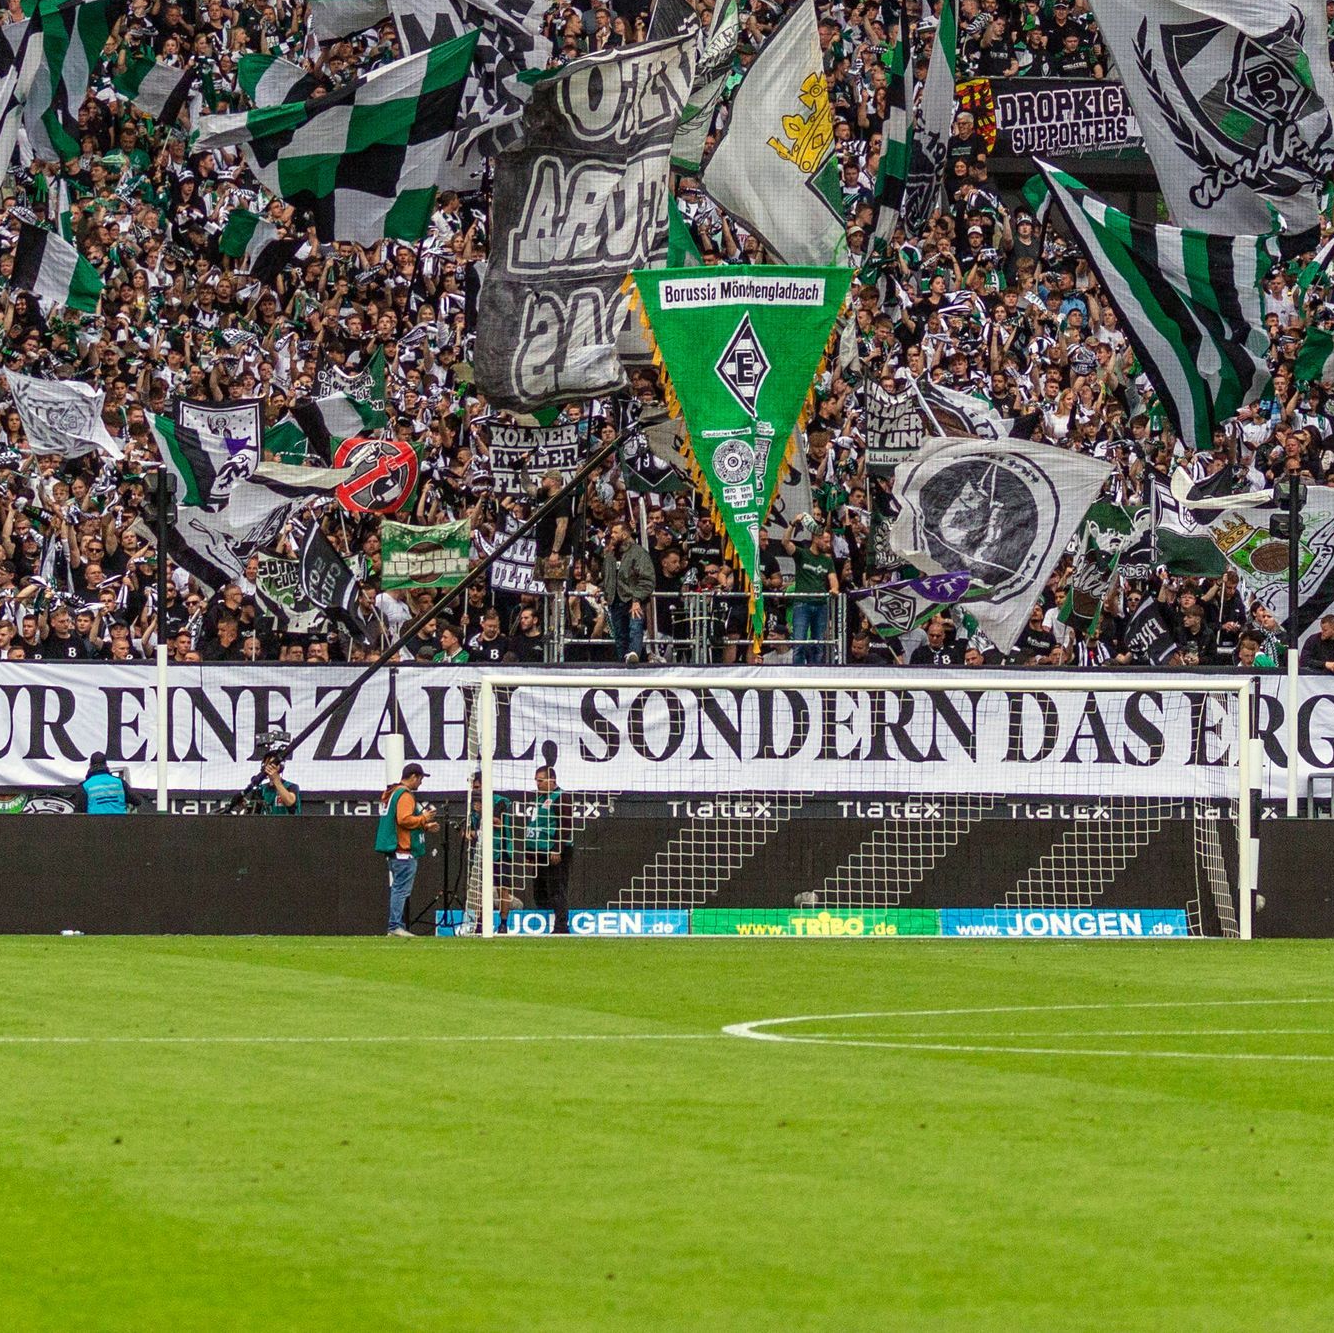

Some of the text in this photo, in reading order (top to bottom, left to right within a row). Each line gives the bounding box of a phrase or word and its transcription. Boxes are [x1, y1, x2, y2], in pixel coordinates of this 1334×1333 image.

[1012, 116, 1128, 154] SUPPORTERS
[664, 280, 820, 303] Borussia Mönchengladbach
[492, 447, 578, 468] KELER
[98, 685, 294, 764] EINE
[579, 689, 978, 764] SONDERN
[1006, 689, 1166, 766] DAS
